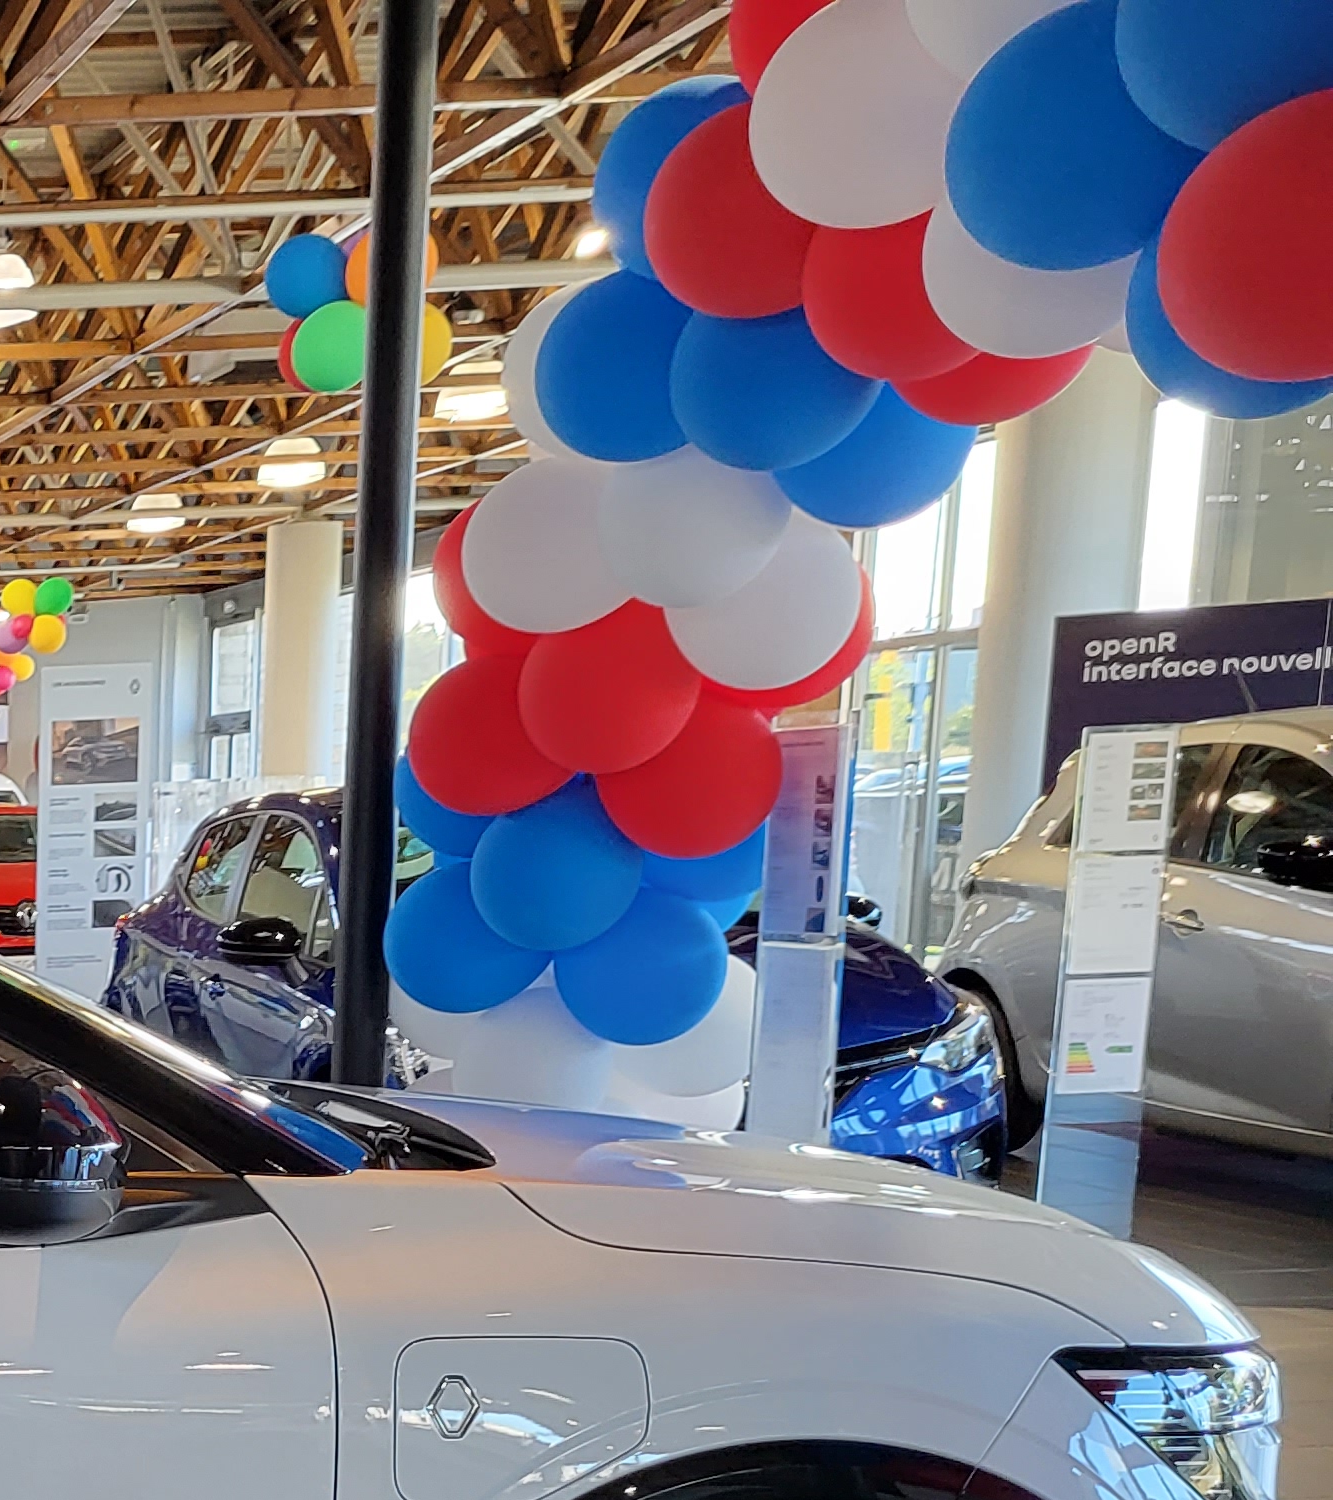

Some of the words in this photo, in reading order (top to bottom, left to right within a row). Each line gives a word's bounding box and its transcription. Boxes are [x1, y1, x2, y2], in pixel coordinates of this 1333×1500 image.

[1084, 631, 1177, 661] openR
[1082, 656, 1217, 683] interface
[1222, 646, 1333, 676] nouvell
